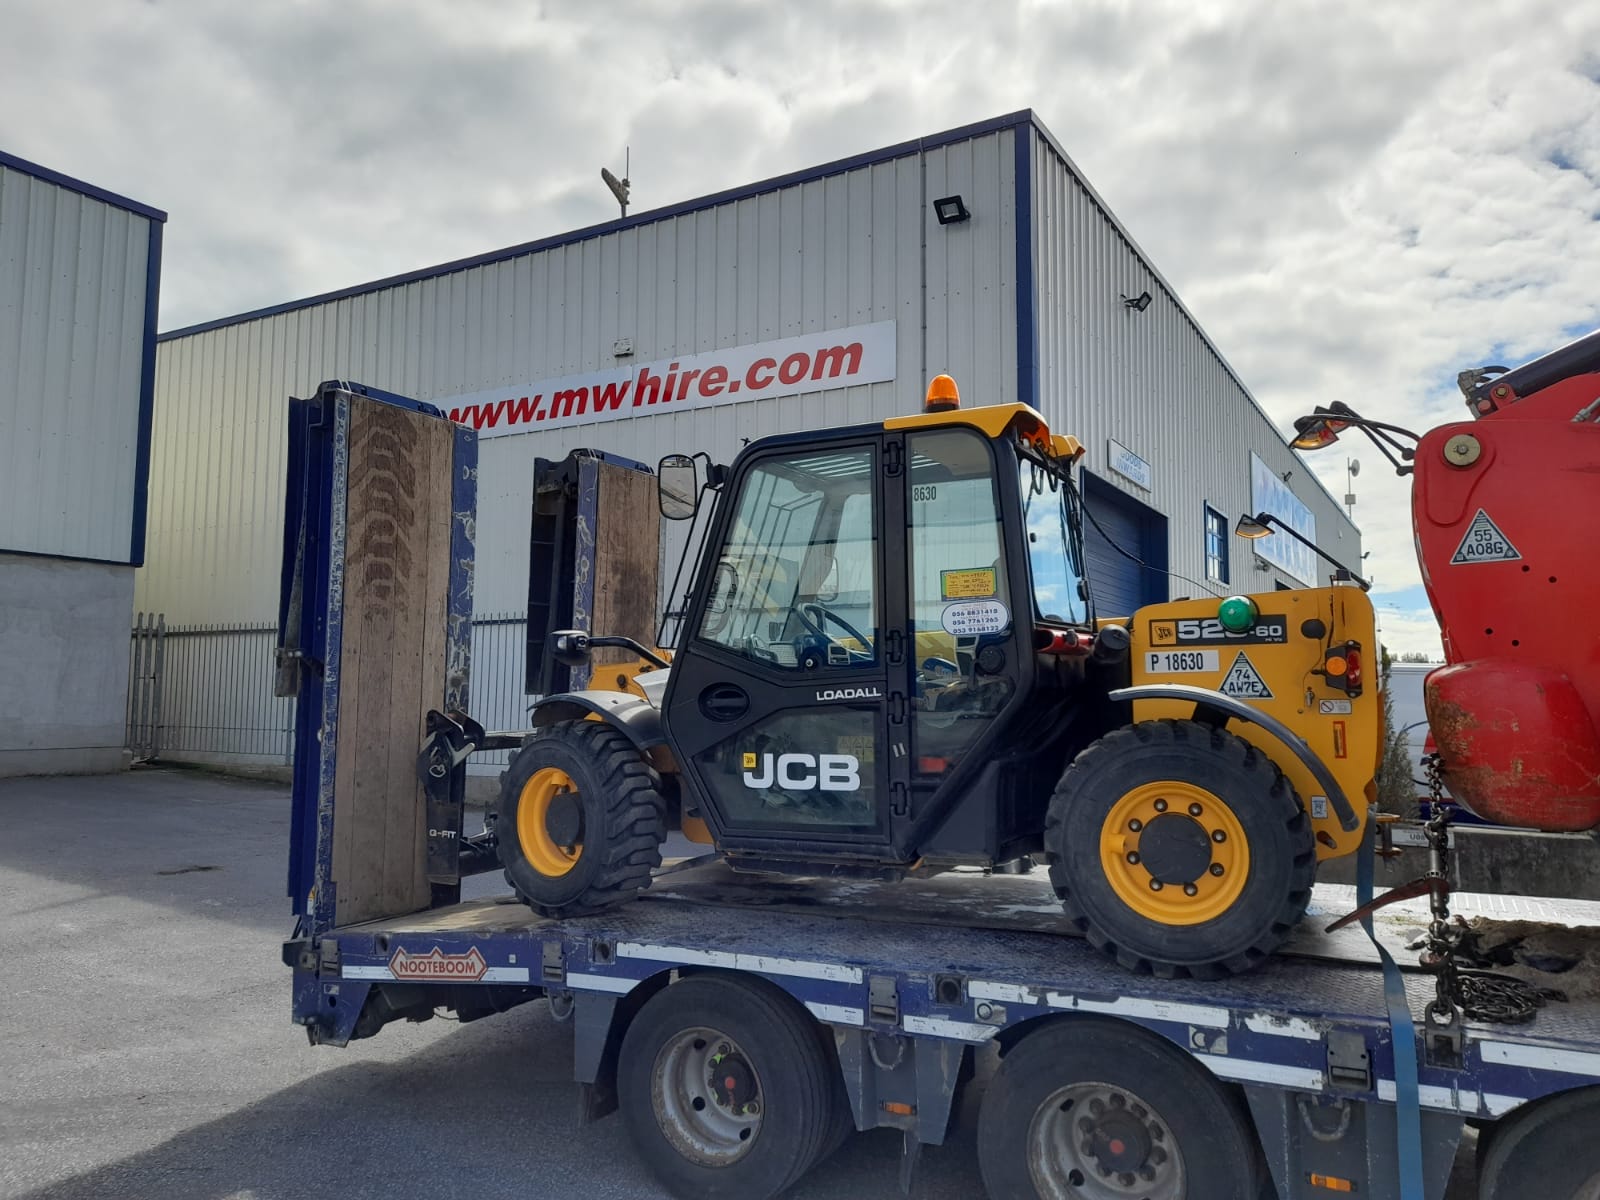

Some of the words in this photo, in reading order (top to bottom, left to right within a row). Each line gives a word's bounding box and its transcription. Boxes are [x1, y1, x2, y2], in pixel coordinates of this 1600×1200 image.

[1474, 529, 1493, 543] 55
[1178, 619, 1283, 640] 52-60
[1151, 654, 1159, 671] P
[1165, 652, 1204, 671] 18630
[1235, 669, 1251, 681] 74
[816, 687, 882, 701] LOADALL
[1228, 681, 1260, 694] AW7E
[743, 753, 861, 791] JCB
[399, 960, 476, 974] NOOTEBOOM
